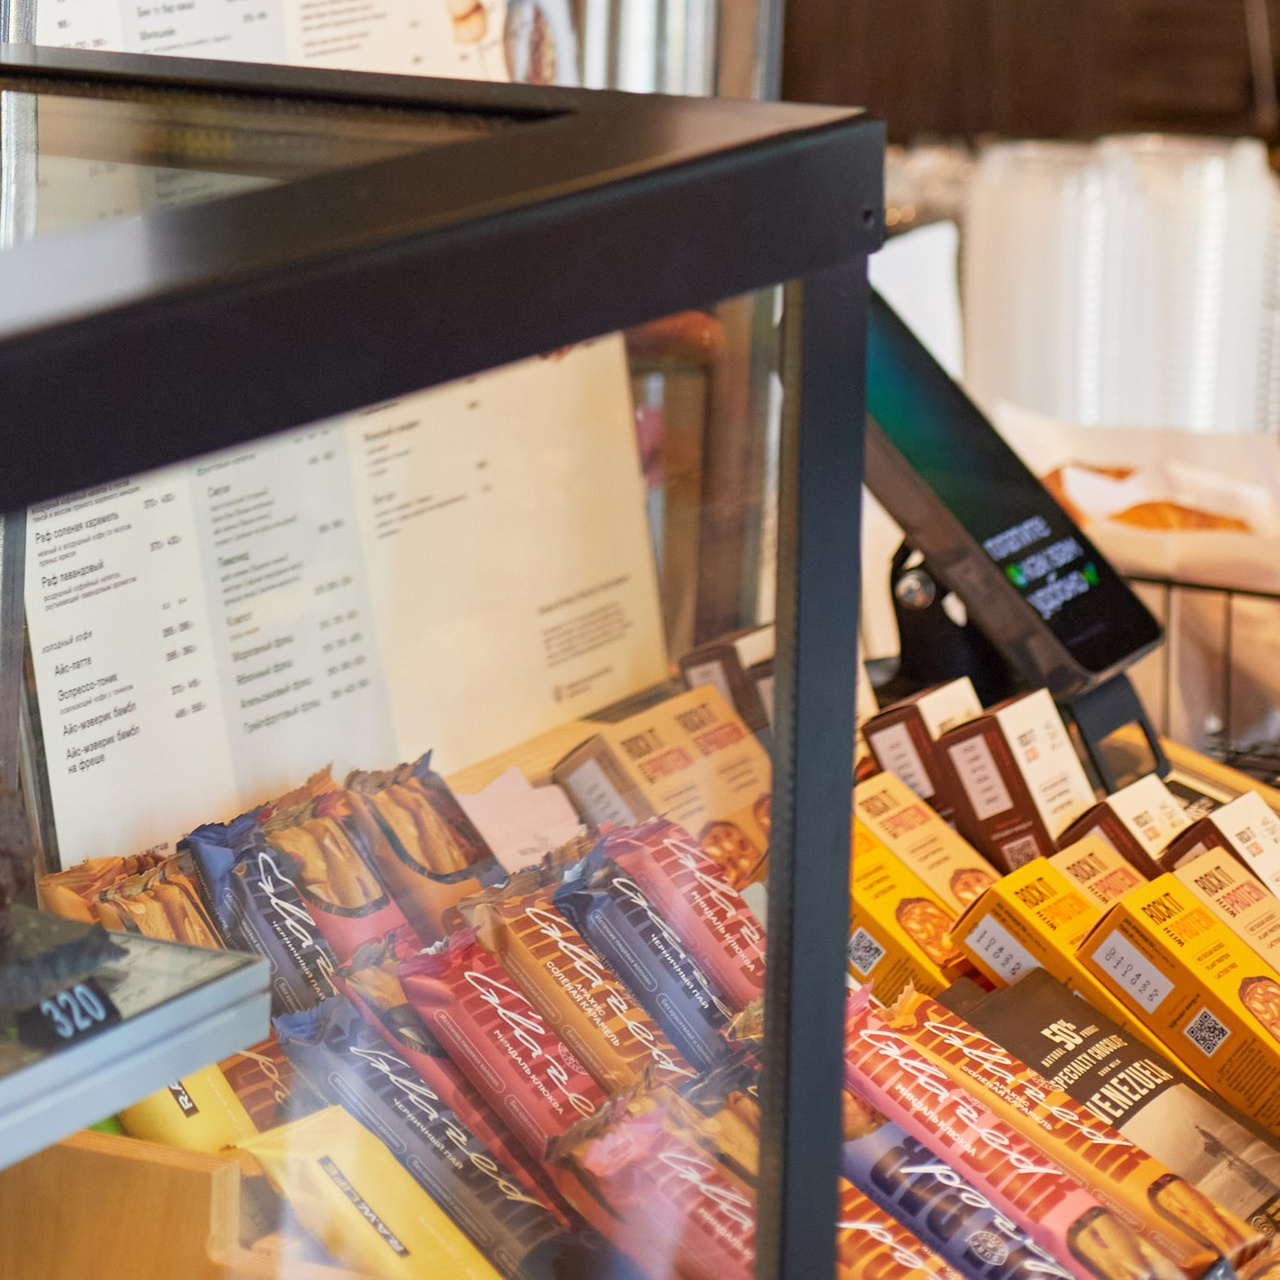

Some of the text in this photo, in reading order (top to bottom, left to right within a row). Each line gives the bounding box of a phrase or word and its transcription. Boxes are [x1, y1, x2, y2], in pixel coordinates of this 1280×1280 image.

[35, 530, 52, 544] Раф
[41, 573, 59, 588] Раф
[1014, 876, 1059, 910] ROCK IT
[1066, 856, 1099, 884] ROCK
[1193, 865, 1236, 898] ROCK IT
[1141, 892, 1185, 926] ROCK IT
[1215, 898, 1237, 919] WITH
[1220, 879, 1267, 914] PROTEIN
[690, 889, 756, 972] МИНДАЛЬ КЛЮКВА
[1035, 910, 1057, 932] WITH
[1163, 926, 1185, 948] WITH
[272, 920, 313, 979] ЧЕРНИЧНЫЙ
[309, 978, 326, 1001] ПАЙ
[651, 933, 711, 1011] ЧЕРНИЧНЫЙ ПАЙ
[40, 983, 107, 1039] 320
[525, 905, 700, 1080] Glazed
[545, 959, 621, 1048] СОЛЁНАЯ КАРАМЕЛЬ
[573, 981, 606, 1018] АРАХИС
[464, 970, 596, 1120] Glaze
[1040, 1019, 1084, 1051] 50%
[1041, 1047, 1067, 1068] NATURAL
[492, 1028, 565, 1116] МИНДАЛЬ КЛЮКВА
[924, 1021, 1134, 1147] Glazed
[992, 1080, 1030, 1107] АРАХИС
[1049, 1052, 1097, 1092] SPECIALTY
[1083, 1058, 1174, 1126] VENEZUELA
[859, 1029, 1063, 1176] Glazed
[895, 1083, 977, 1157] МИНДАЛЬ КЛЮКВА
[960, 1065, 1053, 1131] СОЛЁНАЯ КАРАМЕЛЬ
[349, 1046, 552, 1211] Glazed
[393, 1097, 464, 1170] ЧЕРНИЧНЫЙ ПАЙ
